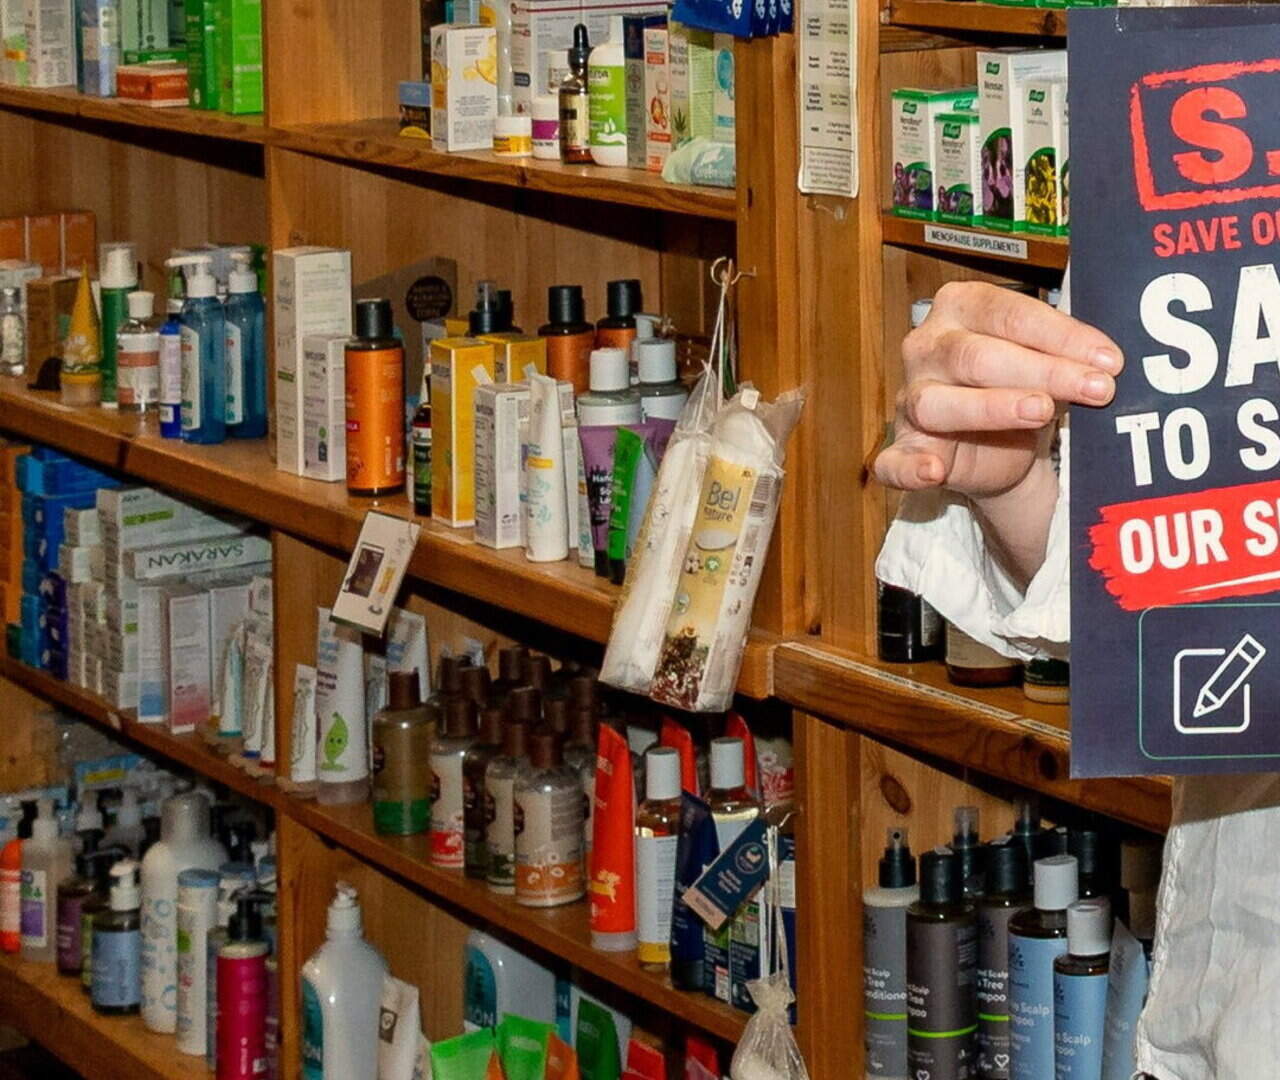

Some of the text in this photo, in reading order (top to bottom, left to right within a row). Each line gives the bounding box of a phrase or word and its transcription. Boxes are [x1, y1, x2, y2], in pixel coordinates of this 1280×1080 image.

[931, 229, 1020, 254] MENOPAUSE SUPPLEMENTS
[1153, 216, 1241, 258] SAVE
[1115, 407, 1211, 486] TO
[1119, 508, 1228, 574] OUR
